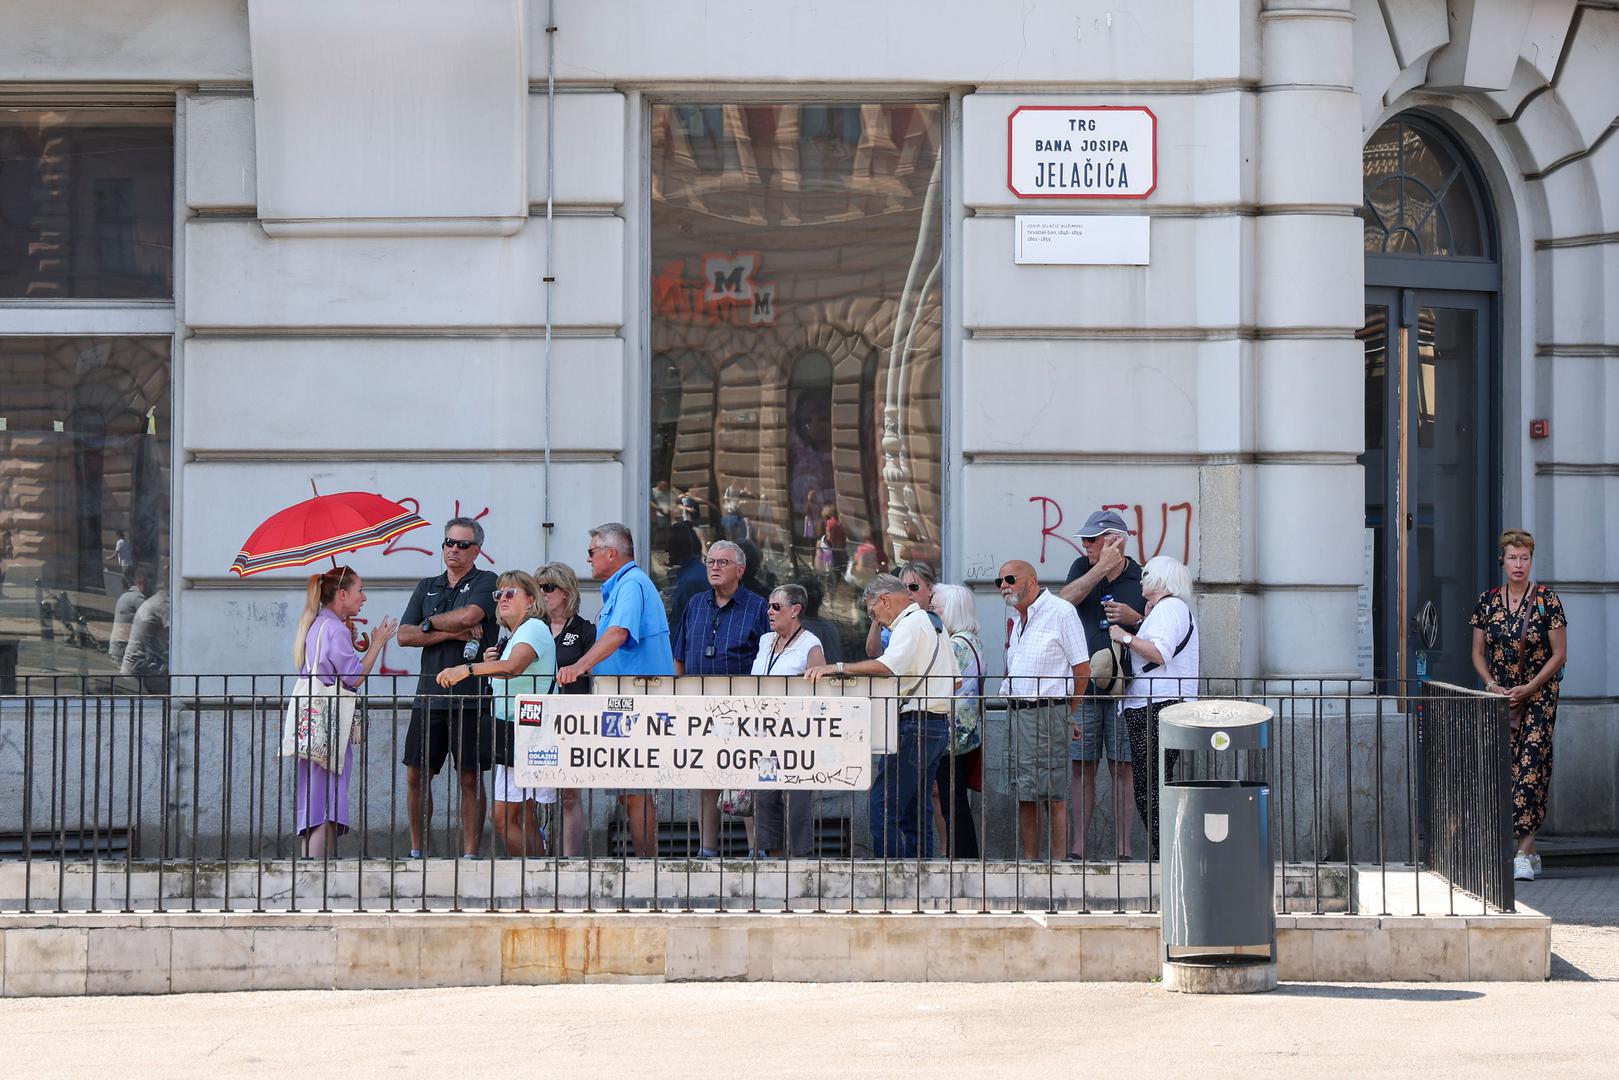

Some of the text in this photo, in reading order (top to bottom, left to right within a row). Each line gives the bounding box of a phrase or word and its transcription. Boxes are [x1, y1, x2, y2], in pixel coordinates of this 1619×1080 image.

[1069, 119, 1096, 132] TRG
[1035, 140, 1129, 152] BANA JOSIPA
[1035, 158, 1129, 188] JELAČIĆA
[520, 703, 541, 713] JEN
[520, 711, 541, 720] FUK
[688, 716, 842, 738] PAKIRAJTE
[570, 747, 660, 769] BICIKLE
[673, 748, 704, 769] UZ
